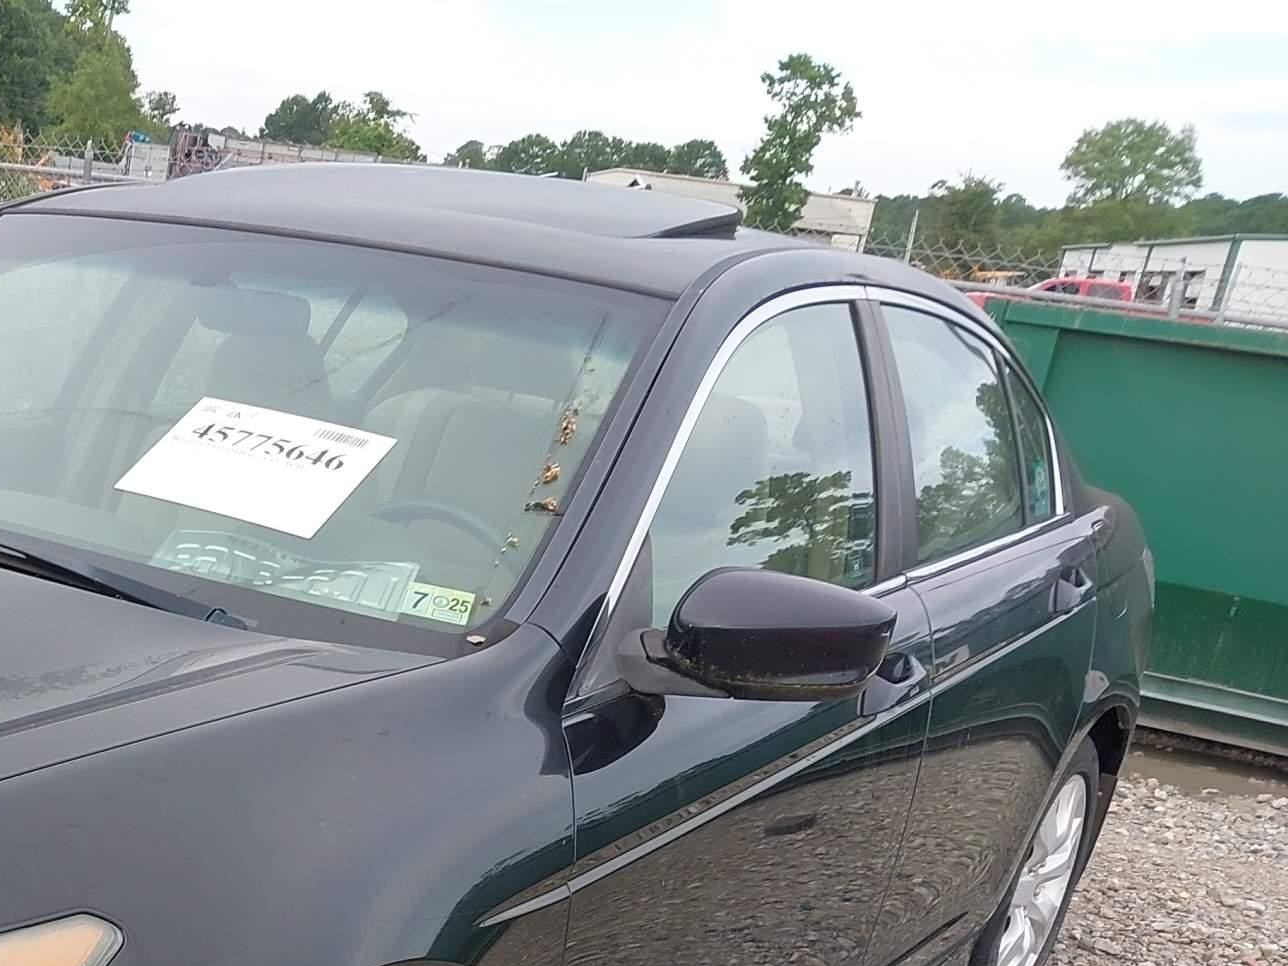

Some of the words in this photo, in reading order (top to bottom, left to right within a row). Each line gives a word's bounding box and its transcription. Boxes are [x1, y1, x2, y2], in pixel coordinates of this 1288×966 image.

[192, 423, 348, 471] 45775646
[412, 590, 429, 609] 7
[448, 598, 470, 614] 25
